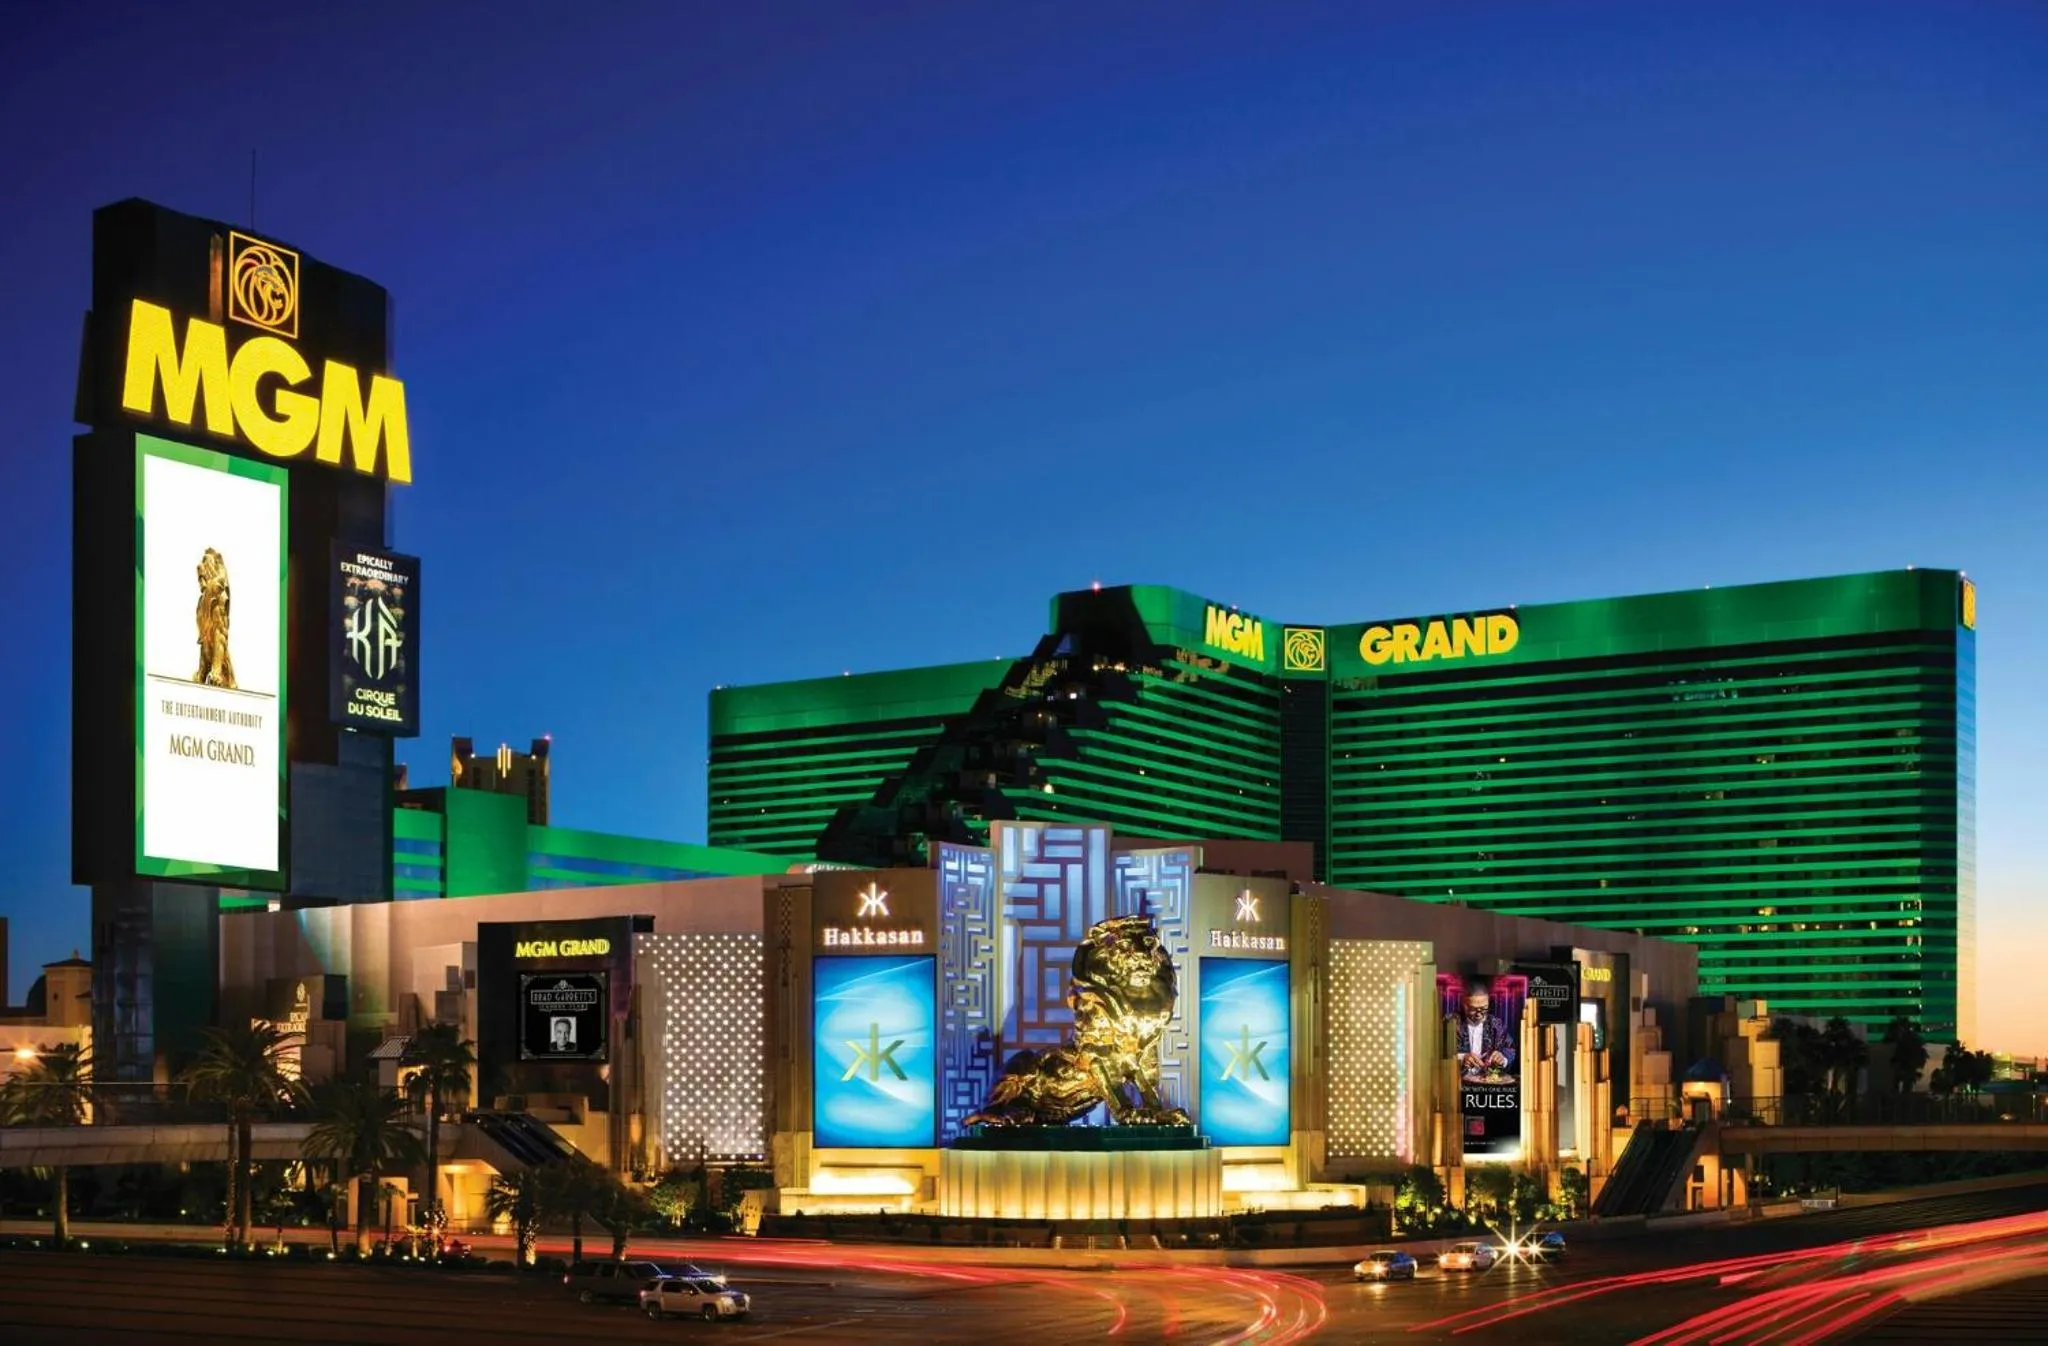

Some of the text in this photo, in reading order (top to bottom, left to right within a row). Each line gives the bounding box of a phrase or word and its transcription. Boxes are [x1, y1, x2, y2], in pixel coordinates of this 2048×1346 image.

[122, 298, 413, 484] MGM
[356, 553, 393, 572] EPICALLY
[340, 561, 409, 586] EXTRAORDINARY
[1205, 605, 1519, 666] MGM GRAND
[355, 687, 396, 707] CIRQUE
[161, 700, 262, 729] THE ENTERTAINMENT AUTHORITY
[347, 701, 403, 722] DU SOLEIL
[169, 733, 203, 759] MGM
[823, 926, 924, 946] Hakkasan
[1211, 930, 1285, 950] Hakkasan
[515, 938, 610, 958] MGM GRAND
[1465, 1094, 1518, 1109] RULES.
